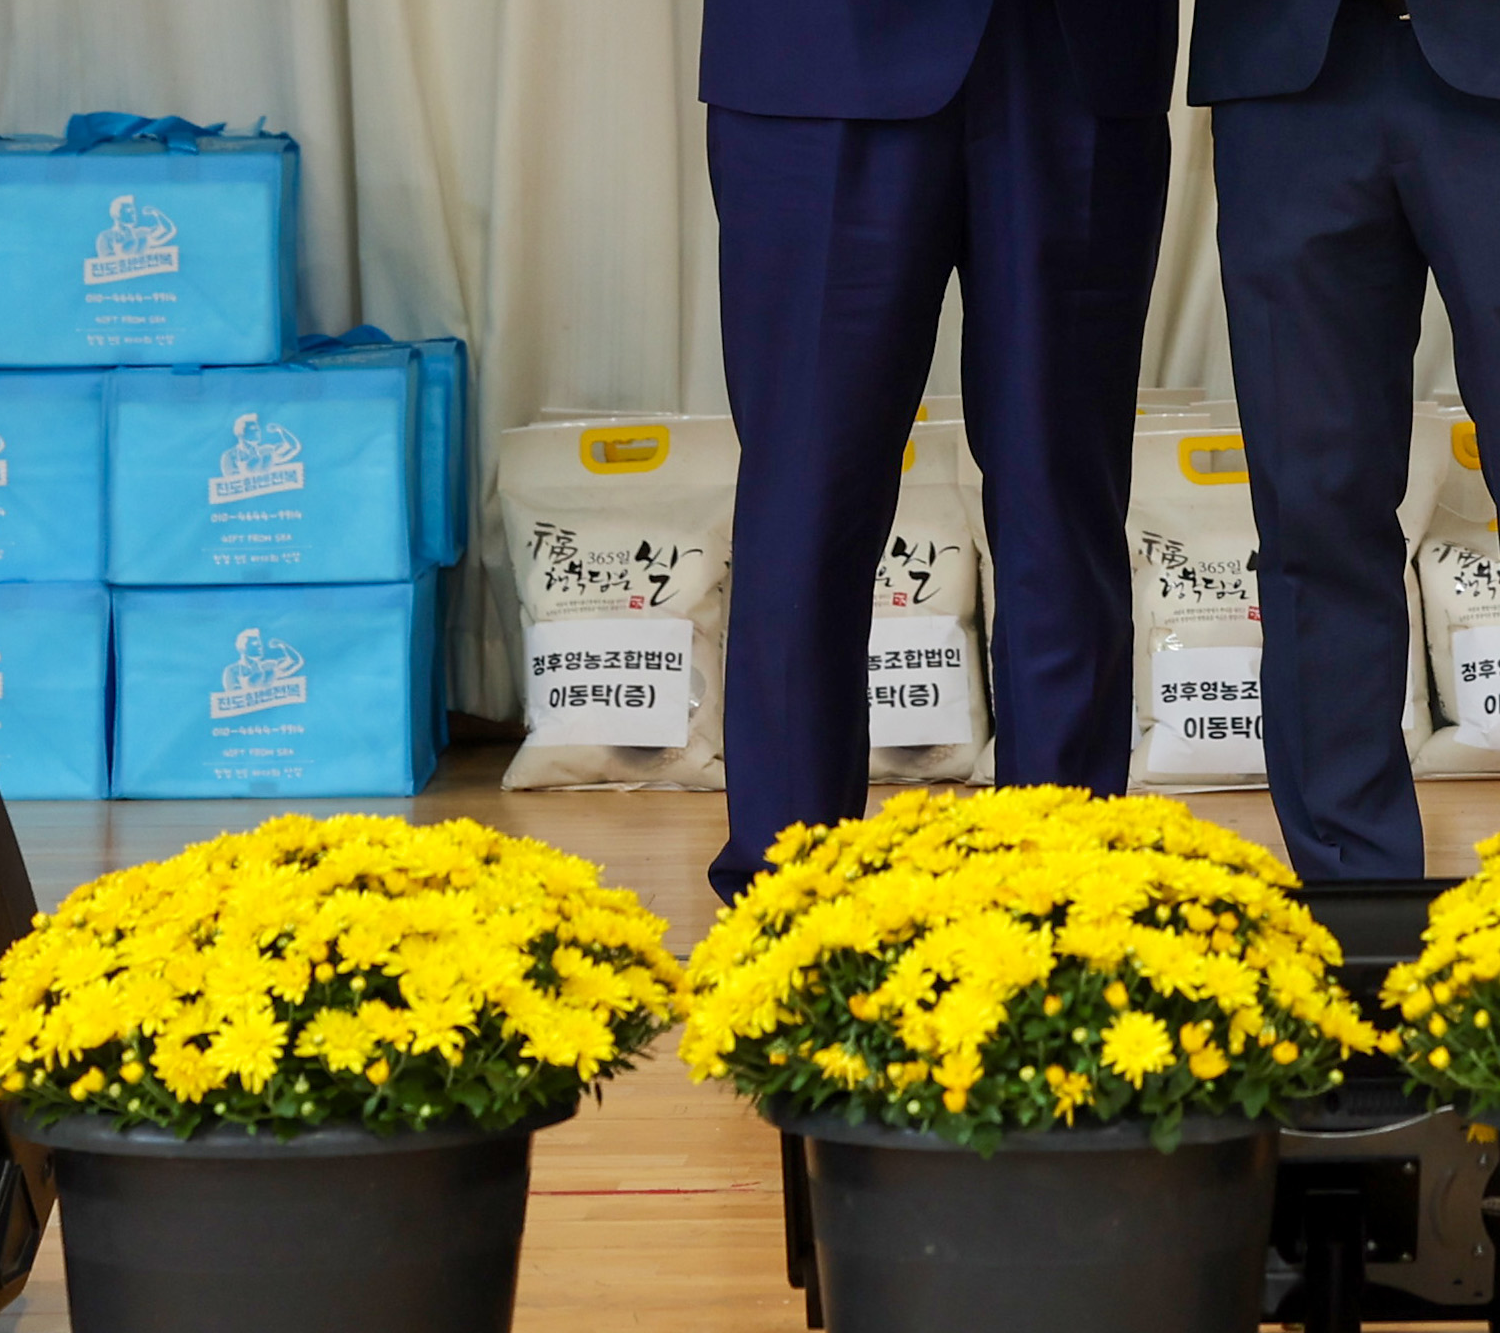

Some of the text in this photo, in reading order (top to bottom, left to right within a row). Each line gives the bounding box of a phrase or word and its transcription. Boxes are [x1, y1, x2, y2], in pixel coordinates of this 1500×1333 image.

[587, 550, 630, 566] 365일
[891, 535, 960, 603] 쌀
[1199, 560, 1242, 575] 365일
[635, 540, 703, 606] 쌀
[532, 650, 682, 676] 정후영농조합법인
[868, 648, 961, 672] 농조합법인
[549, 684, 655, 708] 이동탁(증)
[867, 682, 939, 708] 탁(증)
[1161, 680, 1260, 703] 정후영농조
[1185, 715, 1262, 741] 이동탁(
